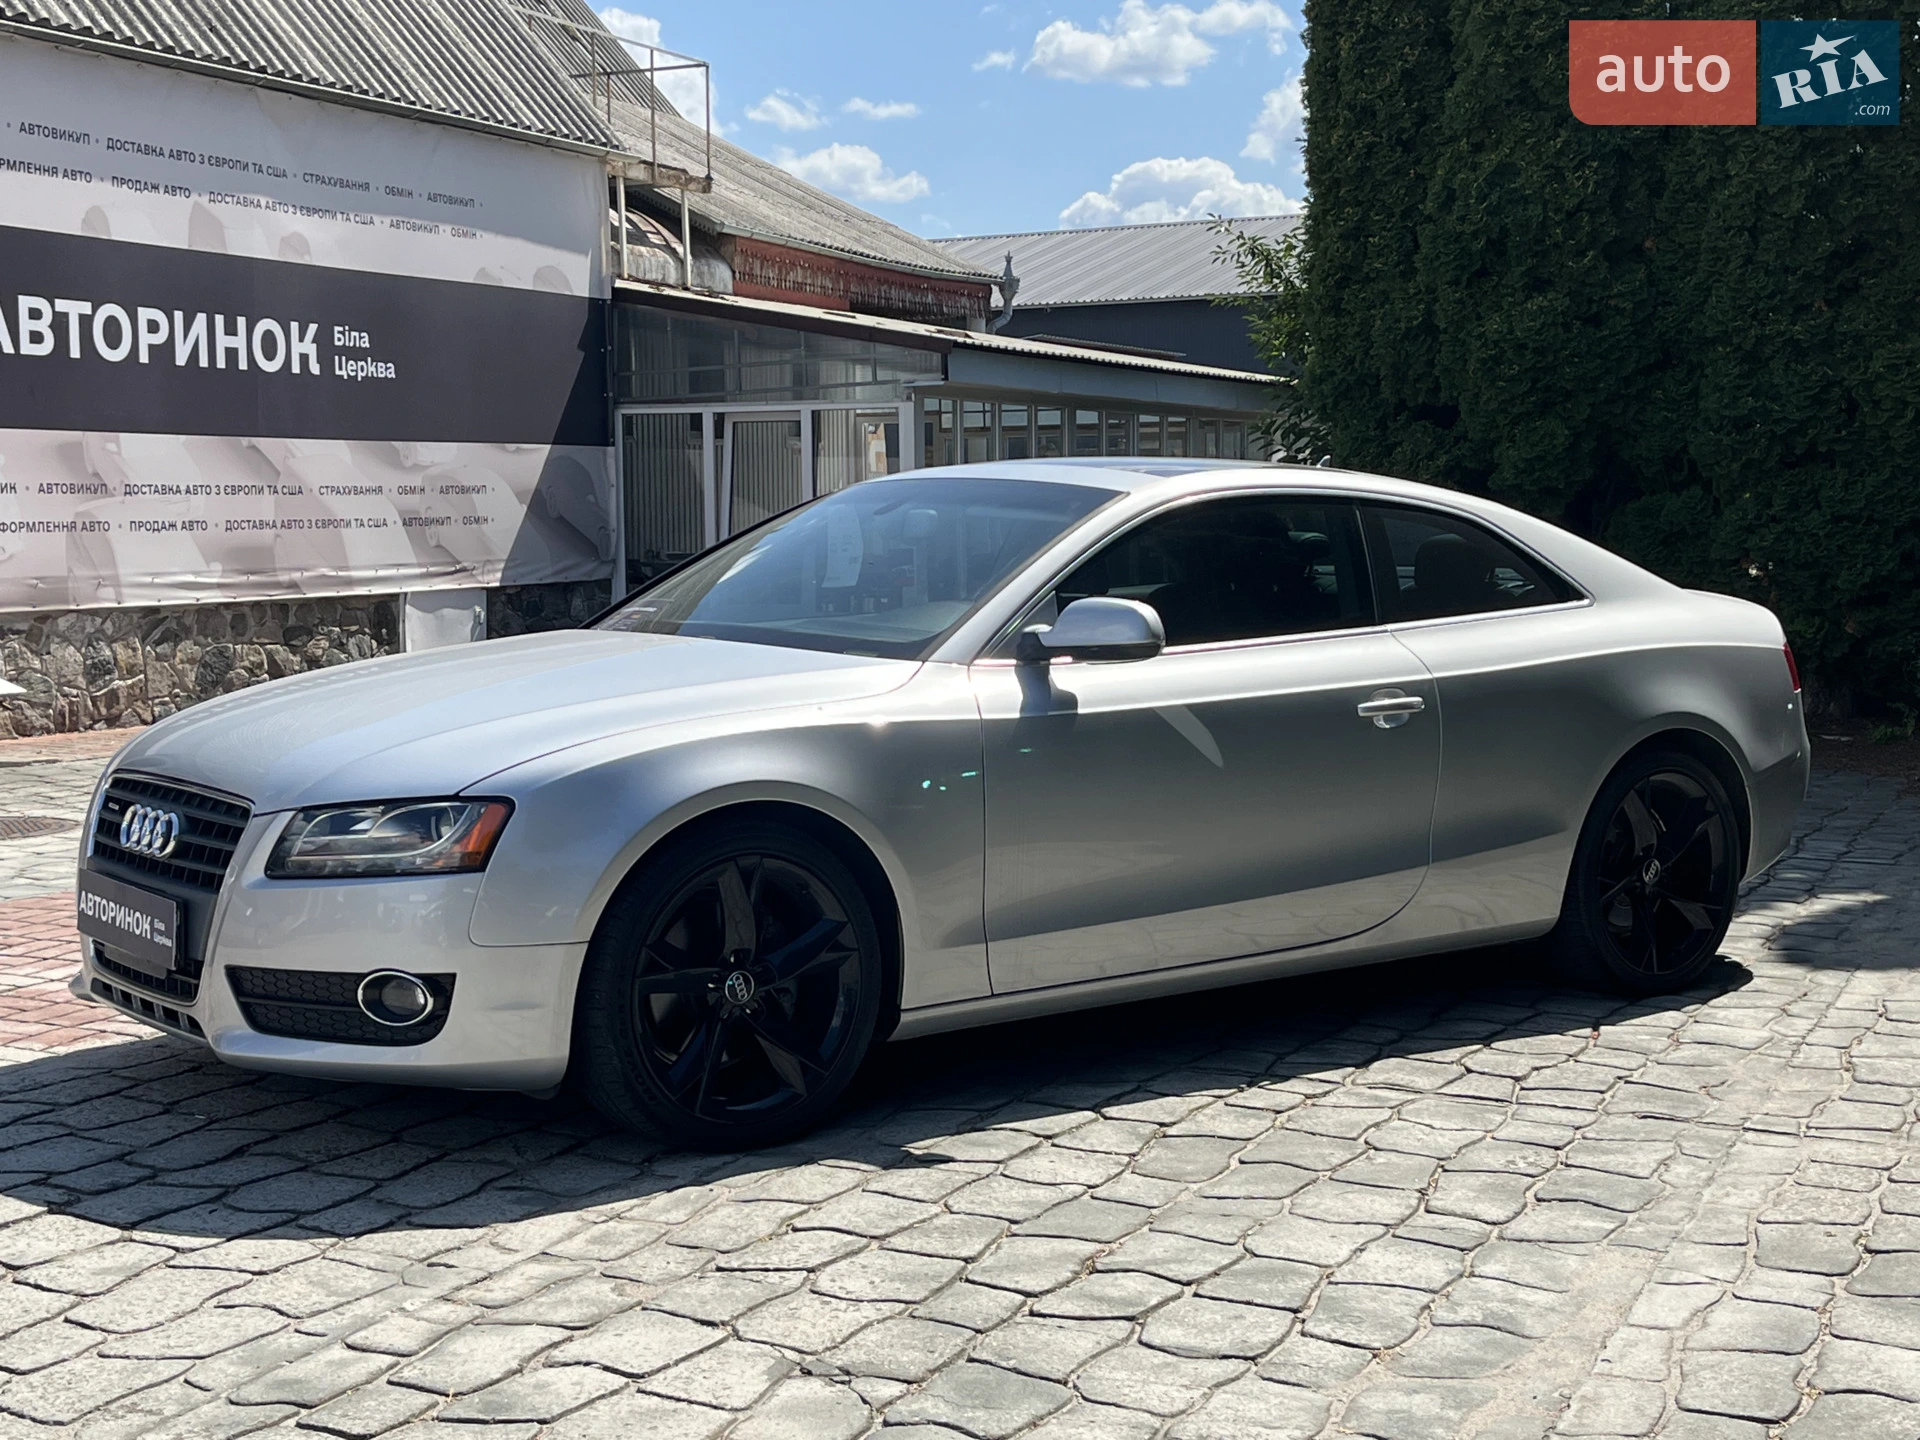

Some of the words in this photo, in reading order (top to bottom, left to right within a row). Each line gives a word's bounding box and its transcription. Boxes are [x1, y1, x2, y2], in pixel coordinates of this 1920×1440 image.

[19, 121, 90, 146] АВТОВИКУП
[106, 137, 165, 159] ДОСТАВКА
[168, 148, 196, 163] АВТО
[207, 156, 249, 173] ЄВРОПИ
[252, 162, 264, 175] ТА
[266, 166, 288, 179] США
[302, 172, 370, 193] СТРАХУВАННЯ
[384, 185, 413, 200] ОБМІН
[427, 191, 475, 209] АВТОВИКУП
[62, 168, 92, 184] АВТО
[112, 175, 160, 194] ПРОДАЖ
[163, 184, 191, 199] АВТО
[208, 191, 262, 210] ДОСТАВКА
[265, 200, 289, 214] АВТО
[299, 206, 338, 221] ЄВРОПИ
[339, 211, 352, 223] ТА
[354, 214, 375, 227] США
[389, 219, 440, 236] АВТОВИКУП
[450, 226, 477, 240] ОБМІН
[333, 325, 371, 349] Біла
[333, 355, 397, 381] Церква
[38, 482, 108, 495] АВТОВИКУП
[124, 484, 181, 497] ДОСТАВКА
[185, 484, 212, 496] АВТО
[224, 485, 264, 496] ЄВРОПИ
[267, 485, 279, 496] ТА
[281, 485, 303, 496] США
[319, 485, 383, 496] СТРАХУВАННЯ
[397, 485, 425, 496] ОБМІН
[439, 484, 487, 495] АВТОВИКУП
[81, 520, 110, 533] АВТО
[130, 520, 178, 534] ПРОДАЖ
[181, 519, 208, 531] АВТО
[225, 519, 277, 532] ДОСТАВКА
[280, 519, 304, 530] АВТО
[315, 518, 351, 530] ЄВРОПИ
[354, 518, 366, 528] ТА
[367, 517, 388, 528] США
[402, 516, 451, 528] АВТОВИКУП
[462, 515, 488, 526] ОБМІН
[79, 890, 151, 939] АВТОРИНОК
